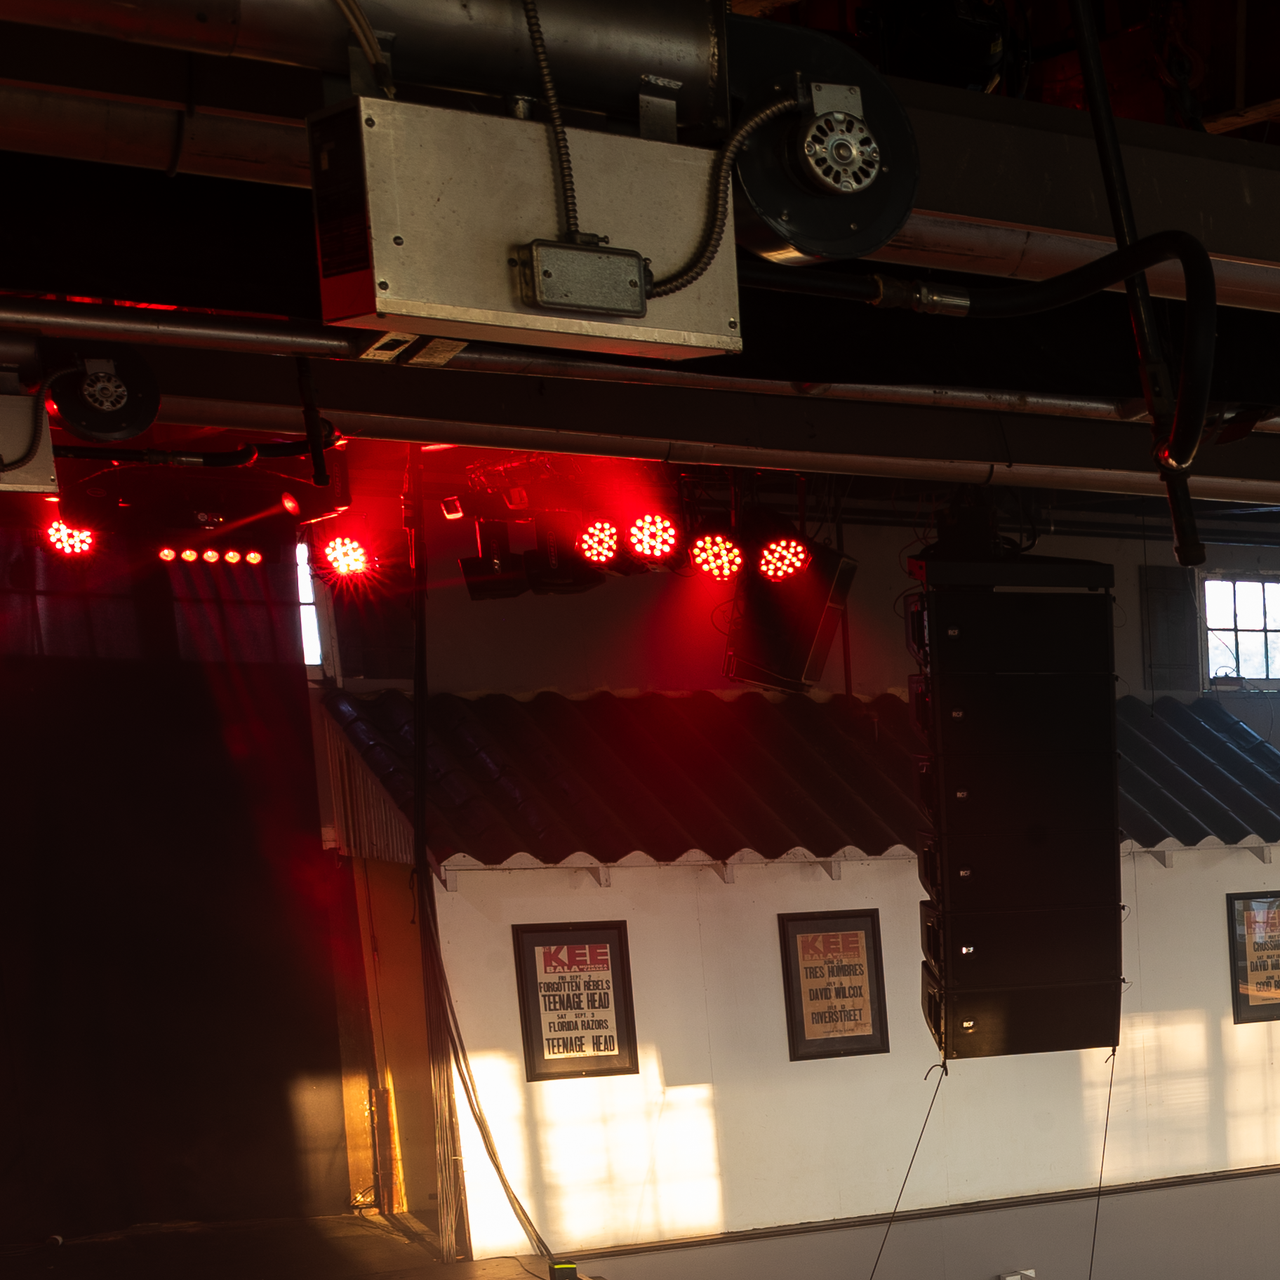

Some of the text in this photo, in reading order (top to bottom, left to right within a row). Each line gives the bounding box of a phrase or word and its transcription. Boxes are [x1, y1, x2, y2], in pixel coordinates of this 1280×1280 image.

[801, 932, 859, 954] KEE
[543, 944, 609, 966] KEE
[546, 965, 580, 973] BALA
[804, 963, 864, 980] TRES HOMBRES
[1250, 959, 1269, 972] DAVID
[539, 980, 611, 993] FORGOTTEN REBELS
[808, 985, 864, 1001] DAVID WILCOX
[1255, 980, 1272, 992] GOOD
[541, 992, 610, 1012] TEENAGE HEAD
[811, 1008, 863, 1025] RIVERSTREET
[548, 1019, 609, 1033] FLORIDA RAZORS
[545, 1035, 616, 1055] TEENAGE HEAD
